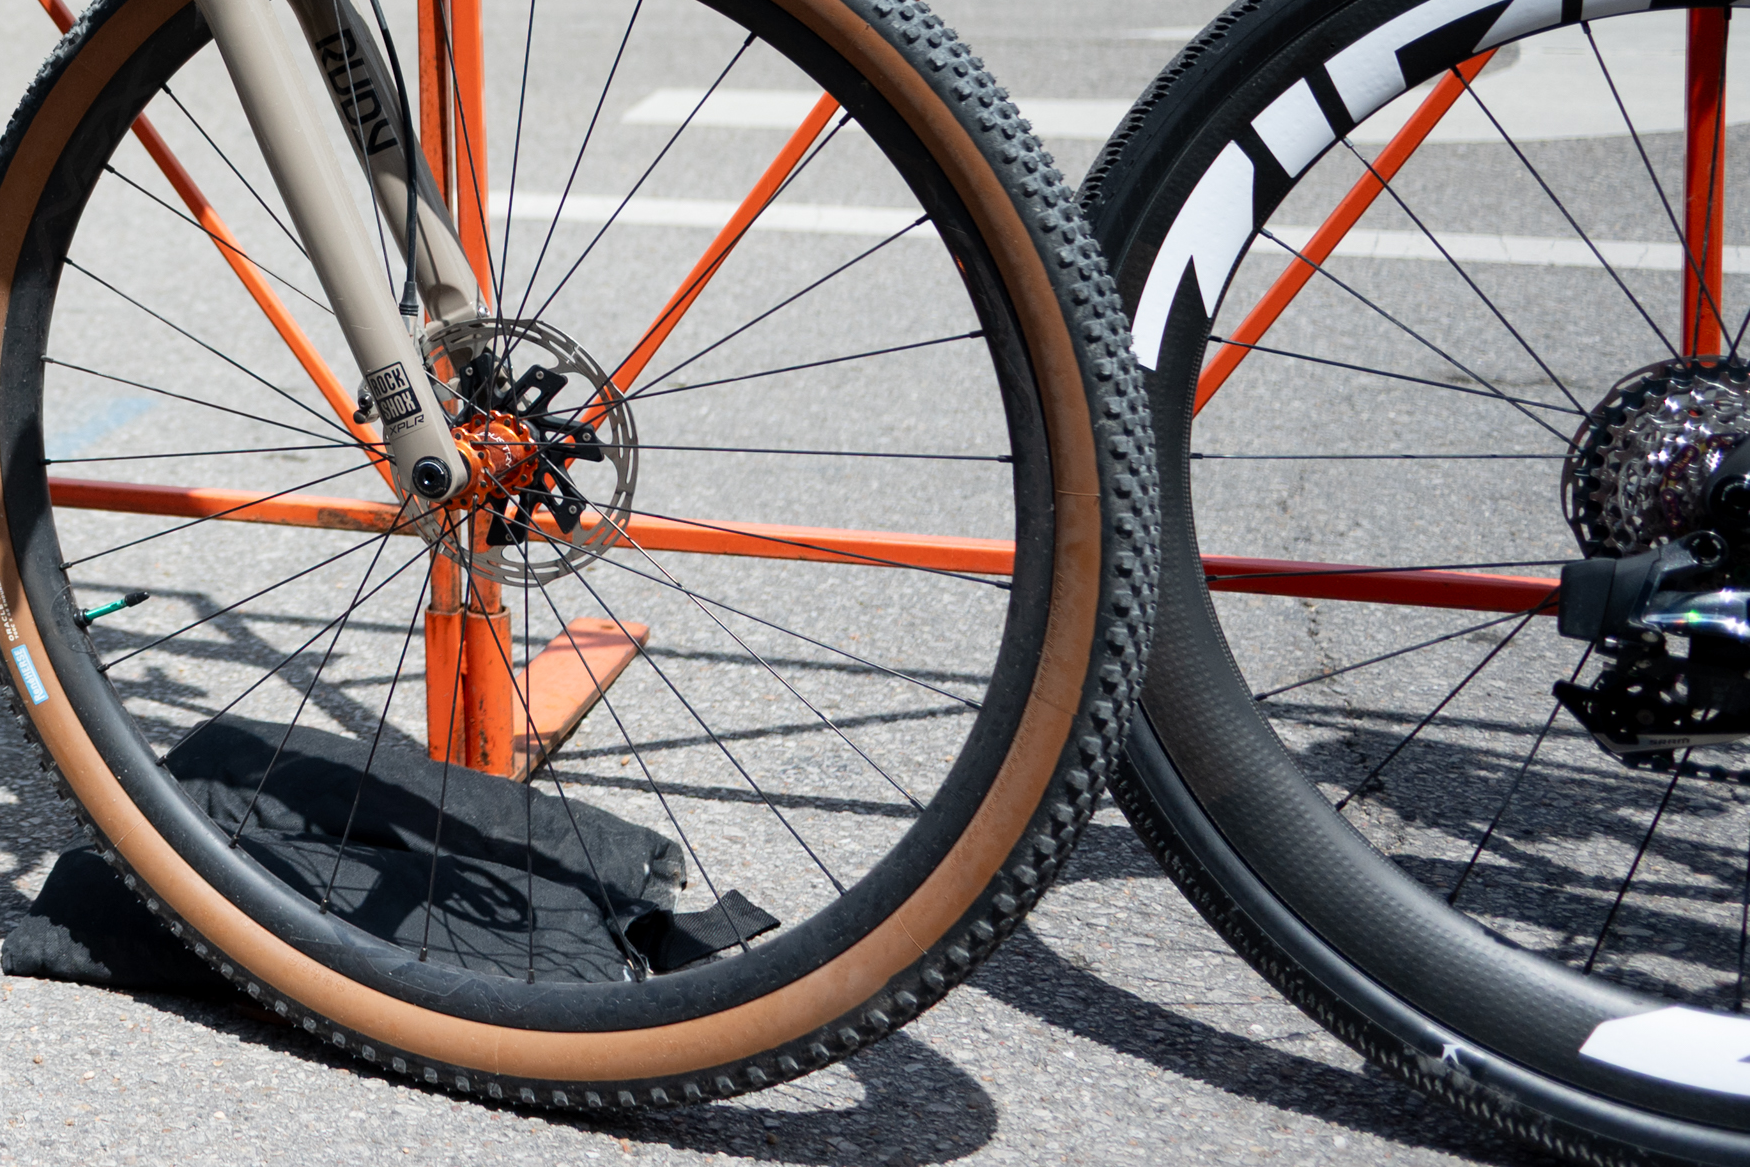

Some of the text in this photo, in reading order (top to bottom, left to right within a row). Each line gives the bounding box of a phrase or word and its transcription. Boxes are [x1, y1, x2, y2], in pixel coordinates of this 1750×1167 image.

[315, 28, 399, 156] RUDY
[370, 368, 406, 397] ROCK
[380, 391, 417, 421] SHOX
[389, 414, 425, 436] XPLR
